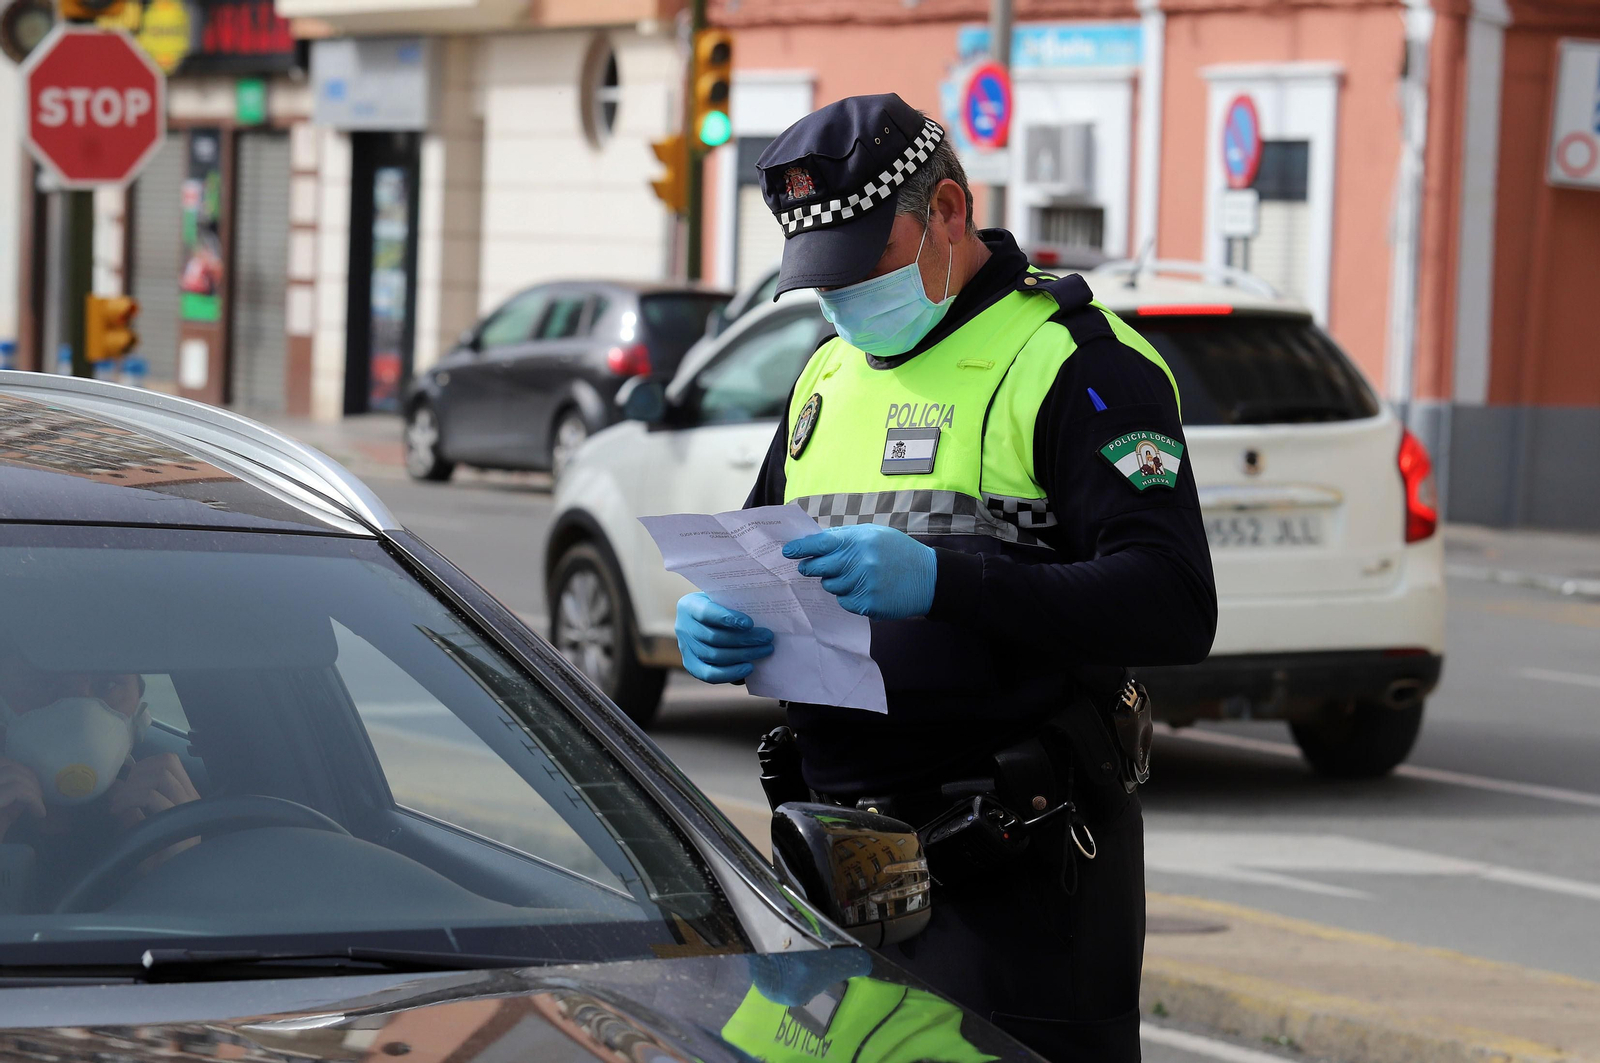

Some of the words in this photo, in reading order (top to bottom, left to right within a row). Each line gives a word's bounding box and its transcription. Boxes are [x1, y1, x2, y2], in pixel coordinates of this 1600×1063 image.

[38, 86, 151, 127] STOP
[885, 403, 955, 429] POLICIA
[1108, 432, 1148, 451] POLICIA
[1149, 433, 1176, 448] LOCAL
[1142, 477, 1170, 486] HUELVA
